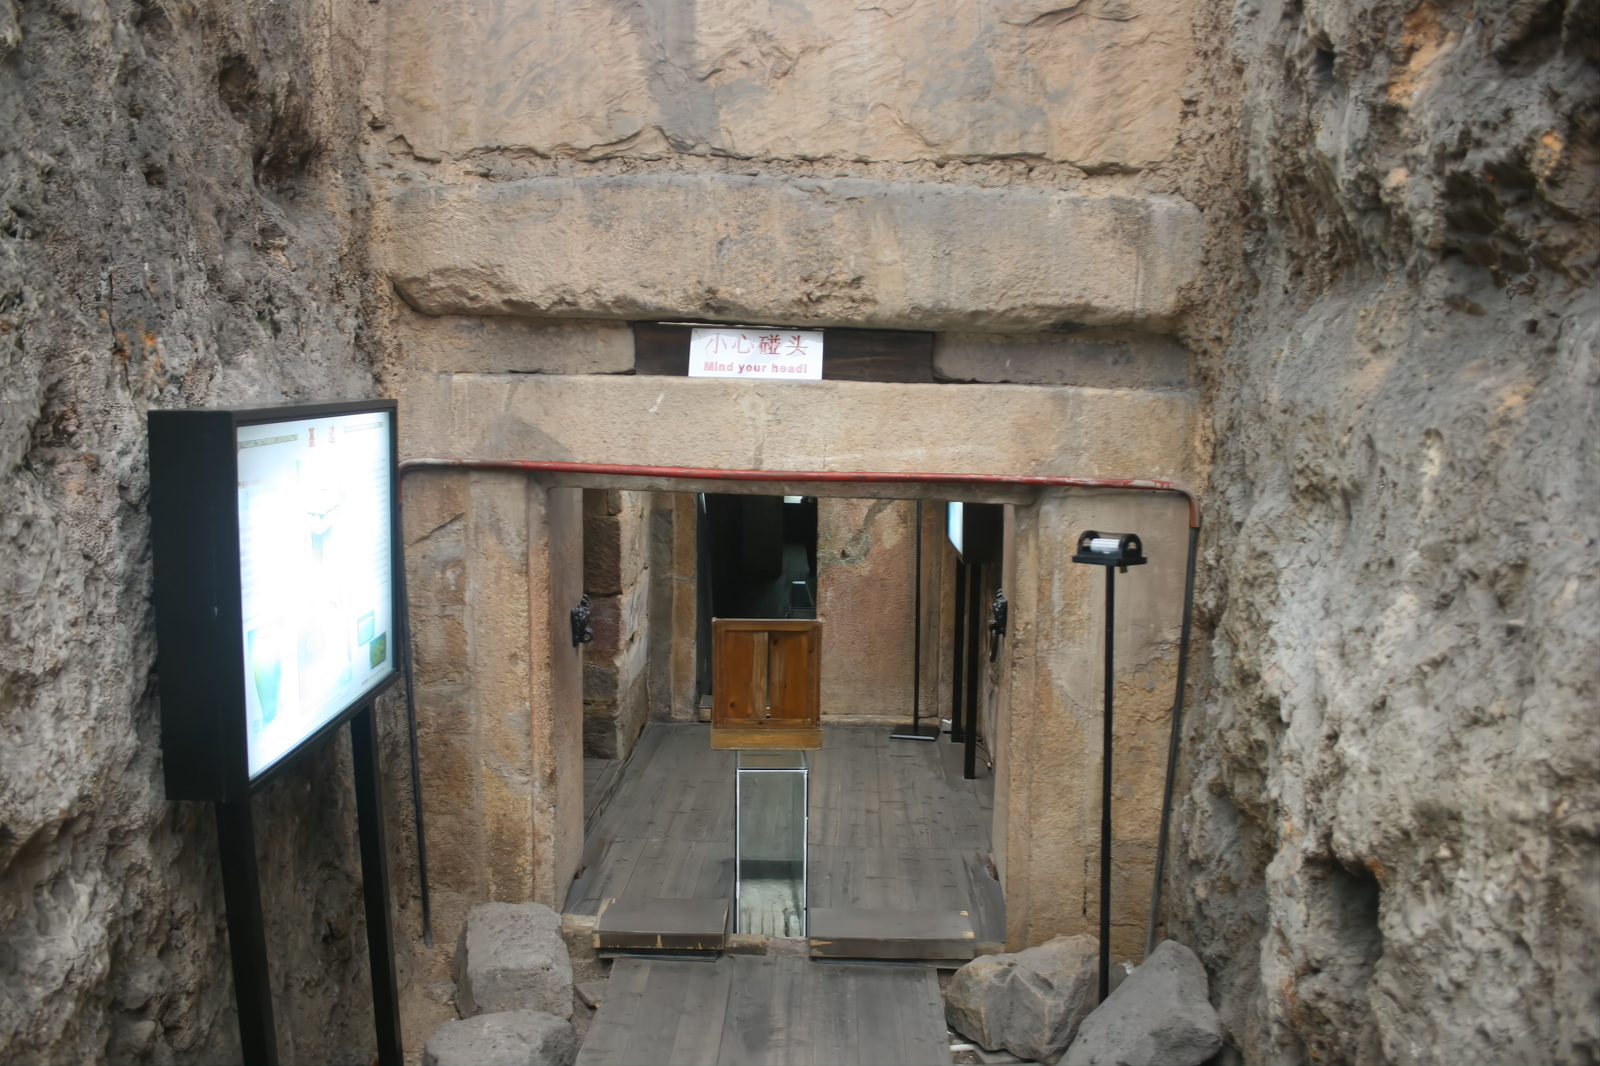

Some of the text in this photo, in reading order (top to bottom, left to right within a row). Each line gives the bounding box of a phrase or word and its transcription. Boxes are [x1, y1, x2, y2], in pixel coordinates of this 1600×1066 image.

[705, 333, 808, 356] 小心碰头
[704, 361, 733, 372] Mind
[738, 364, 767, 374] your
